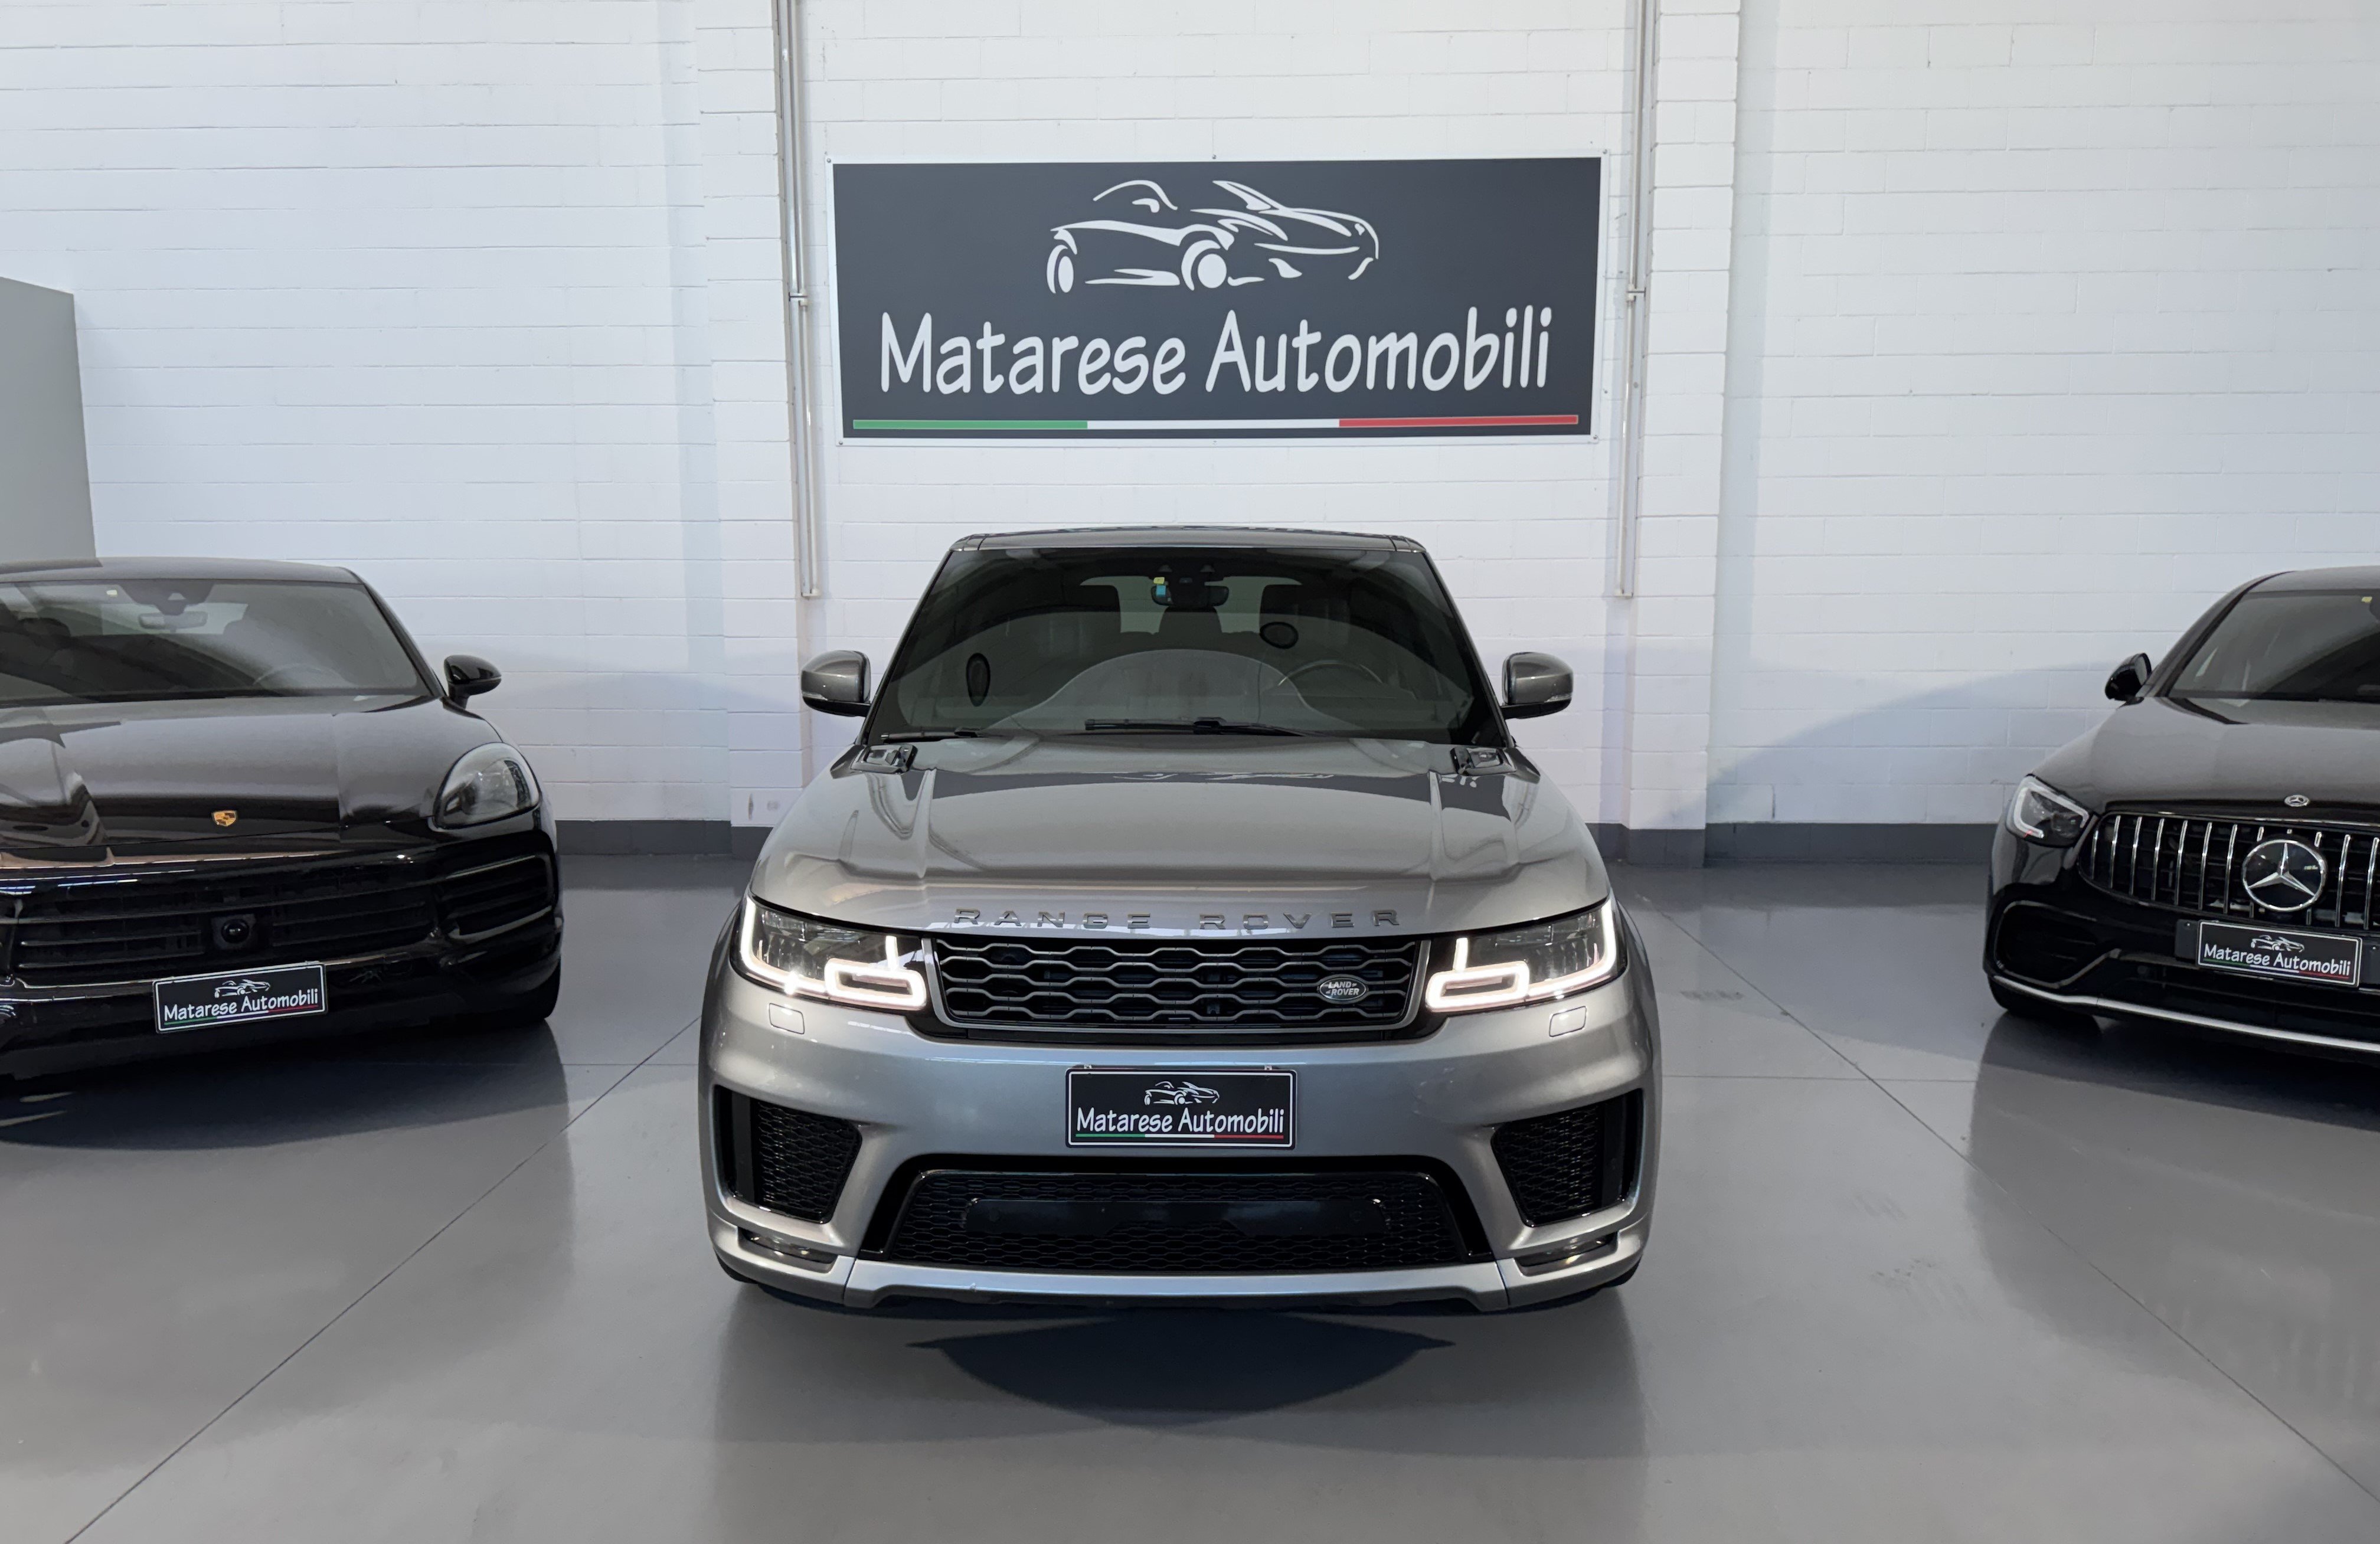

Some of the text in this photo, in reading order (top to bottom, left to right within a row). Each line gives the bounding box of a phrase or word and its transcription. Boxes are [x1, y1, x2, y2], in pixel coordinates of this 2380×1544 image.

[881, 305, 1552, 395] Matarese Automobili
[953, 908, 1400, 930] RANGE ROVER
[2204, 943, 2351, 976] Matarese Automobili
[164, 988, 319, 1021] Matarese Automobili
[1077, 1107, 1285, 1133] Matarese Automobili
